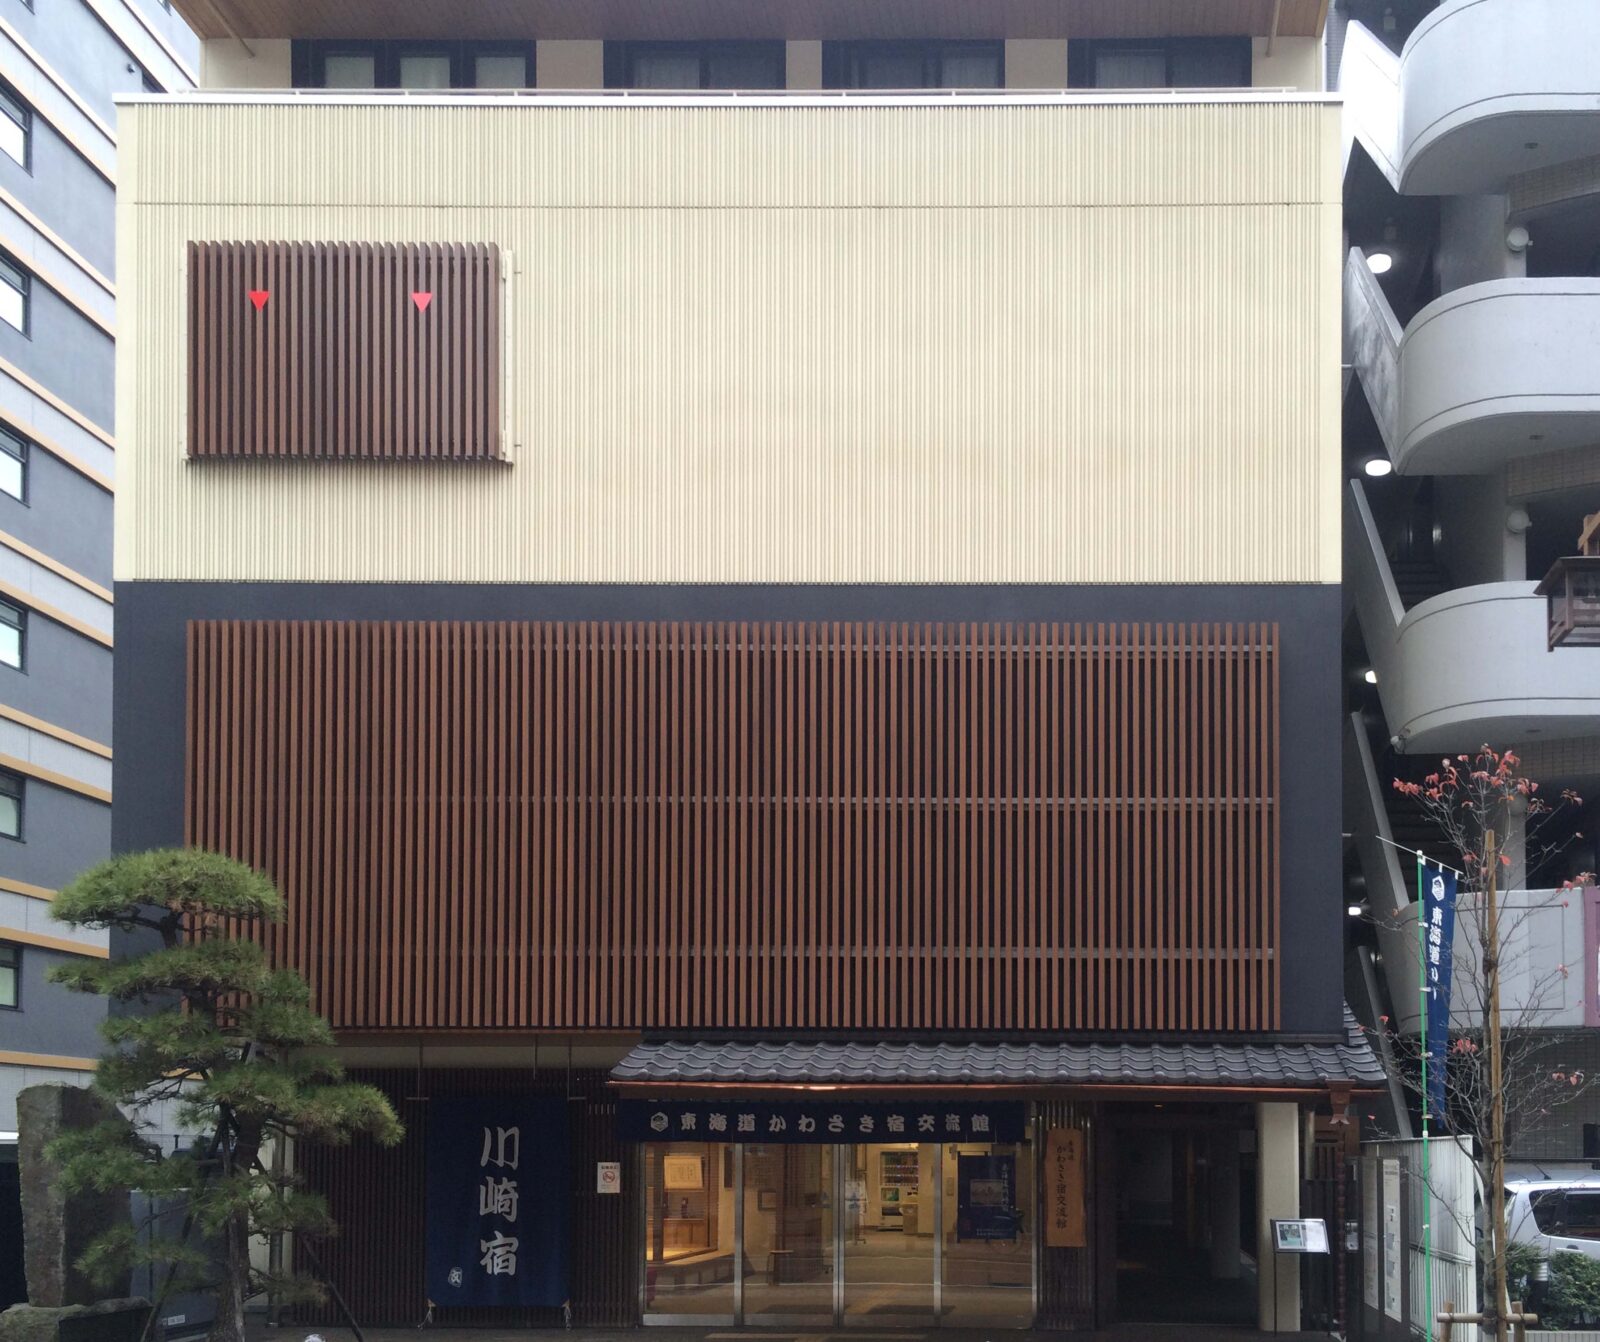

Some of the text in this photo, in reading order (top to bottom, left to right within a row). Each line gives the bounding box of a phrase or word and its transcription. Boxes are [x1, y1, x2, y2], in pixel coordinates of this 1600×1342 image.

[680, 1112, 990, 1132] 東海道かわさき宿交流館
[479, 1126, 521, 1276] 川崎宿
